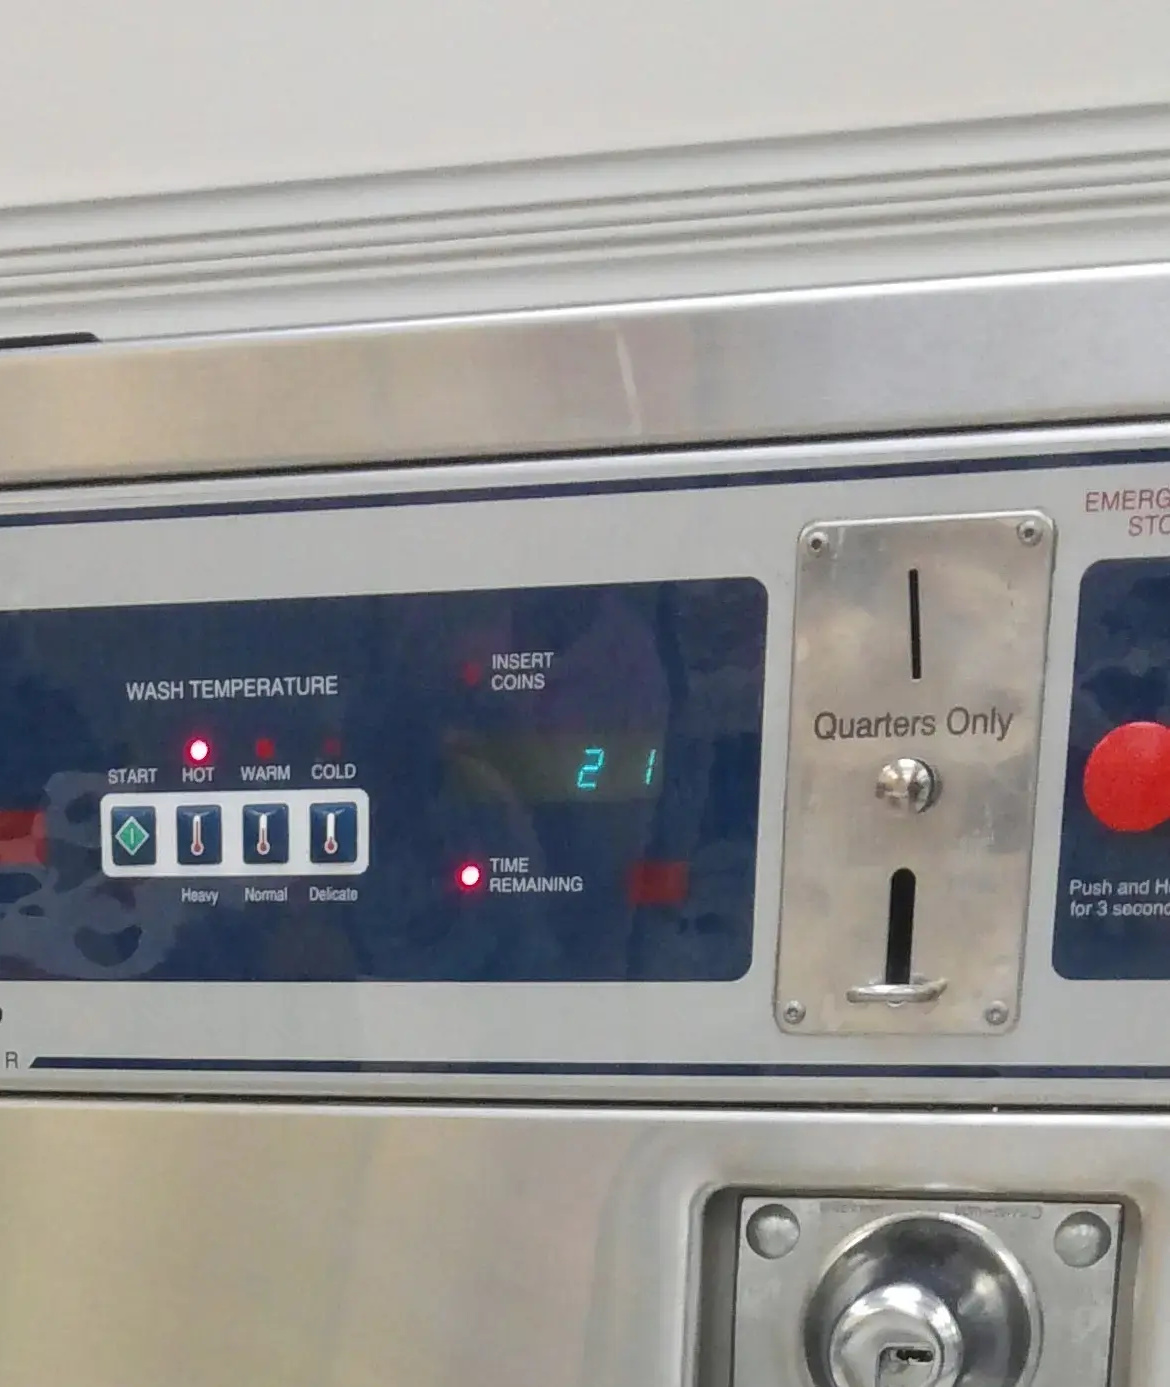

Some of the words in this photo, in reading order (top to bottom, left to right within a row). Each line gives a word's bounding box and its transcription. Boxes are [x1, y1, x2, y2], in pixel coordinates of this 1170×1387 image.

[491, 652, 554, 670] INSERT
[125, 681, 184, 701] WASH
[189, 676, 338, 699] TEMPERATURE
[491, 673, 546, 691] COINS
[814, 711, 936, 740] Quarters
[946, 706, 1014, 742] Only
[108, 768, 158, 784] START
[182, 767, 214, 782] HOT
[240, 765, 291, 781] WARM
[311, 764, 356, 780] COLD
[490, 857, 529, 873] TIME
[489, 876, 583, 893] REMAINING
[1070, 879, 1113, 896] Push
[1117, 879, 1150, 896] and
[181, 887, 219, 905] Heavy
[244, 887, 288, 901] Normal
[309, 886, 358, 901] Delicate
[1070, 900, 1092, 917] for
[1096, 900, 1108, 917] 3
